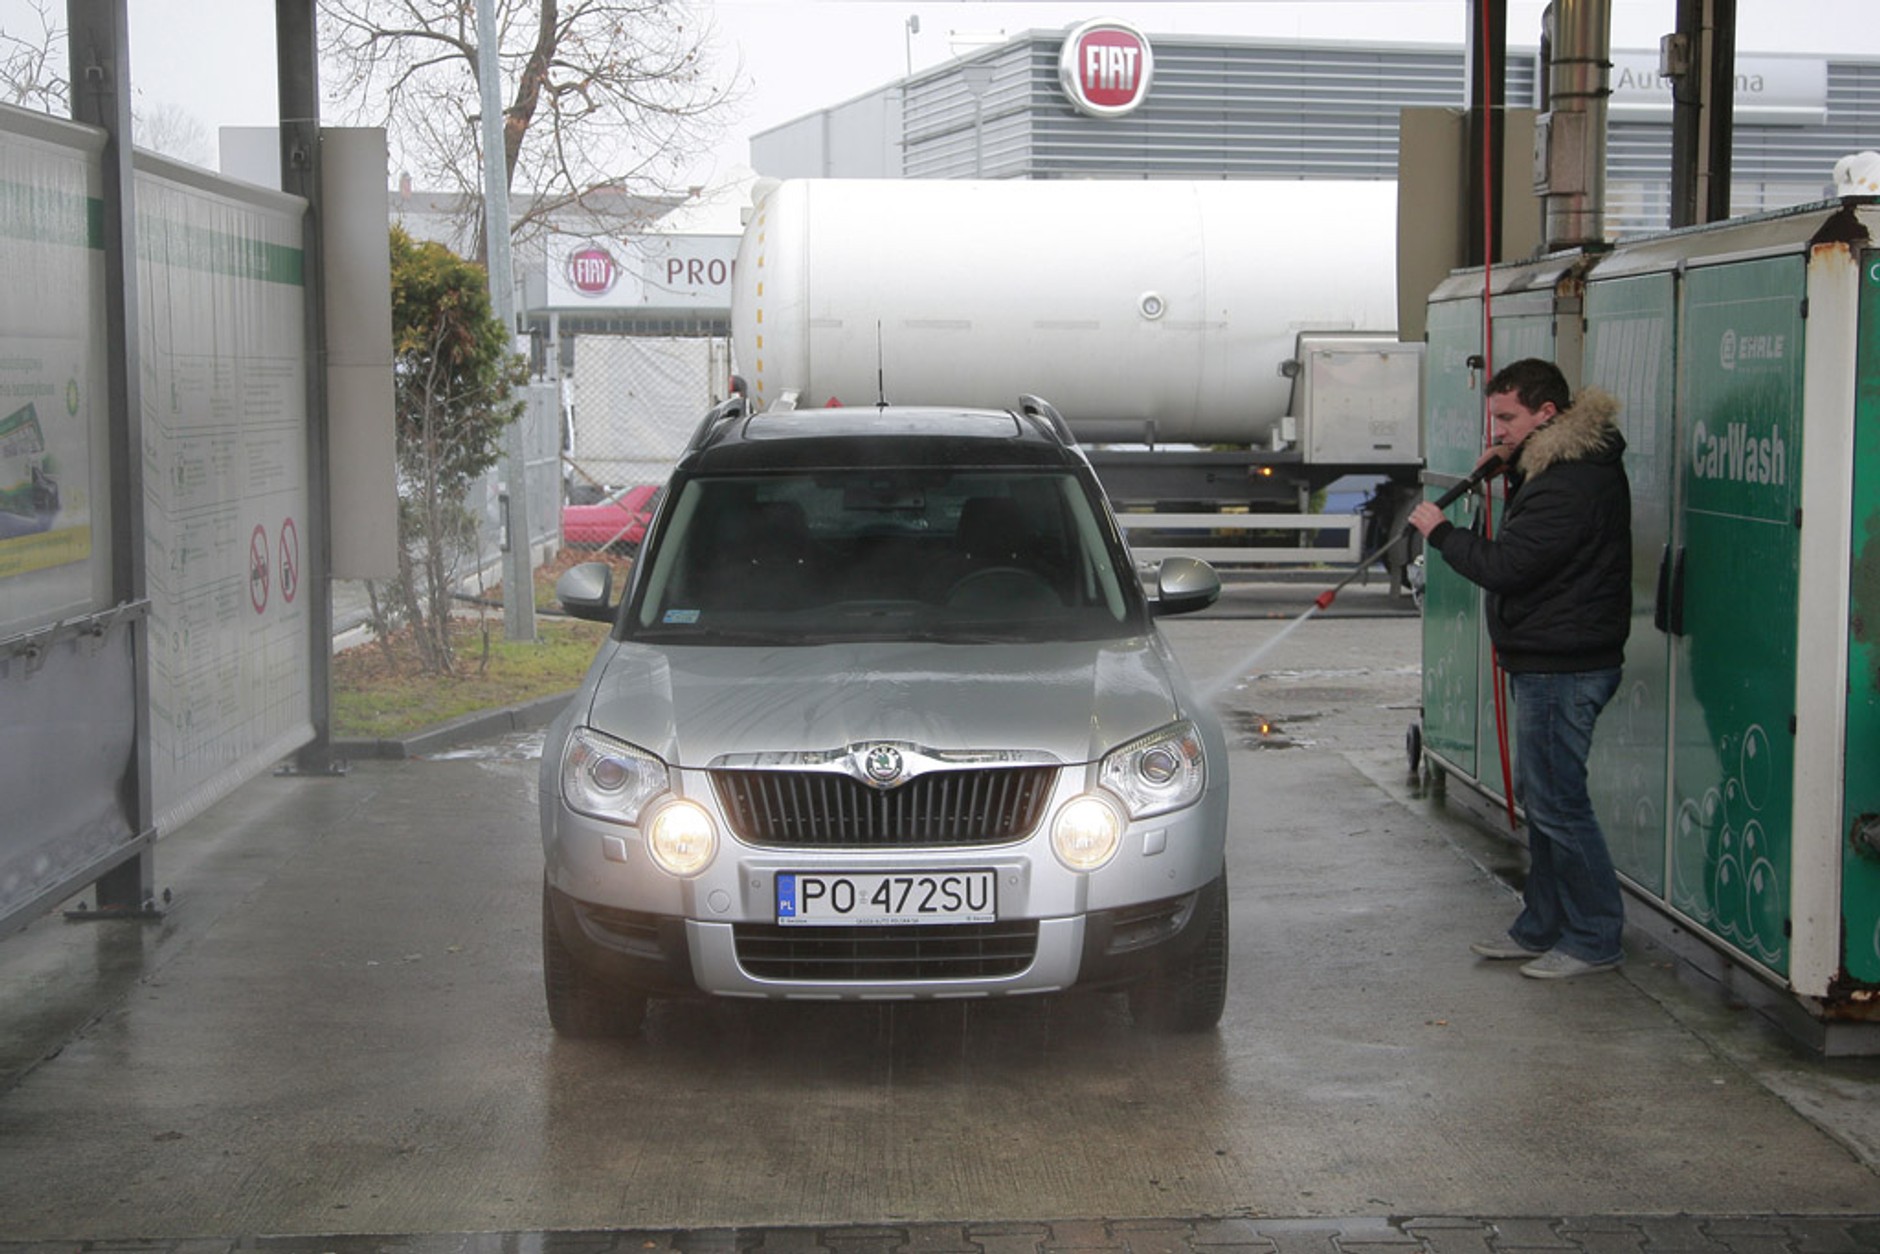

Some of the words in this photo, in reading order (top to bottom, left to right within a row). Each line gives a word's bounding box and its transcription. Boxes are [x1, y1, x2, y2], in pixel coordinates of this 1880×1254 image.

[1086, 45, 1138, 91] FIAT
[577, 258, 608, 284] FIAT
[1692, 419, 1786, 486] CarWash
[780, 900, 794, 910] PL
[802, 878, 855, 914] PO
[870, 876, 987, 914] 472SU
